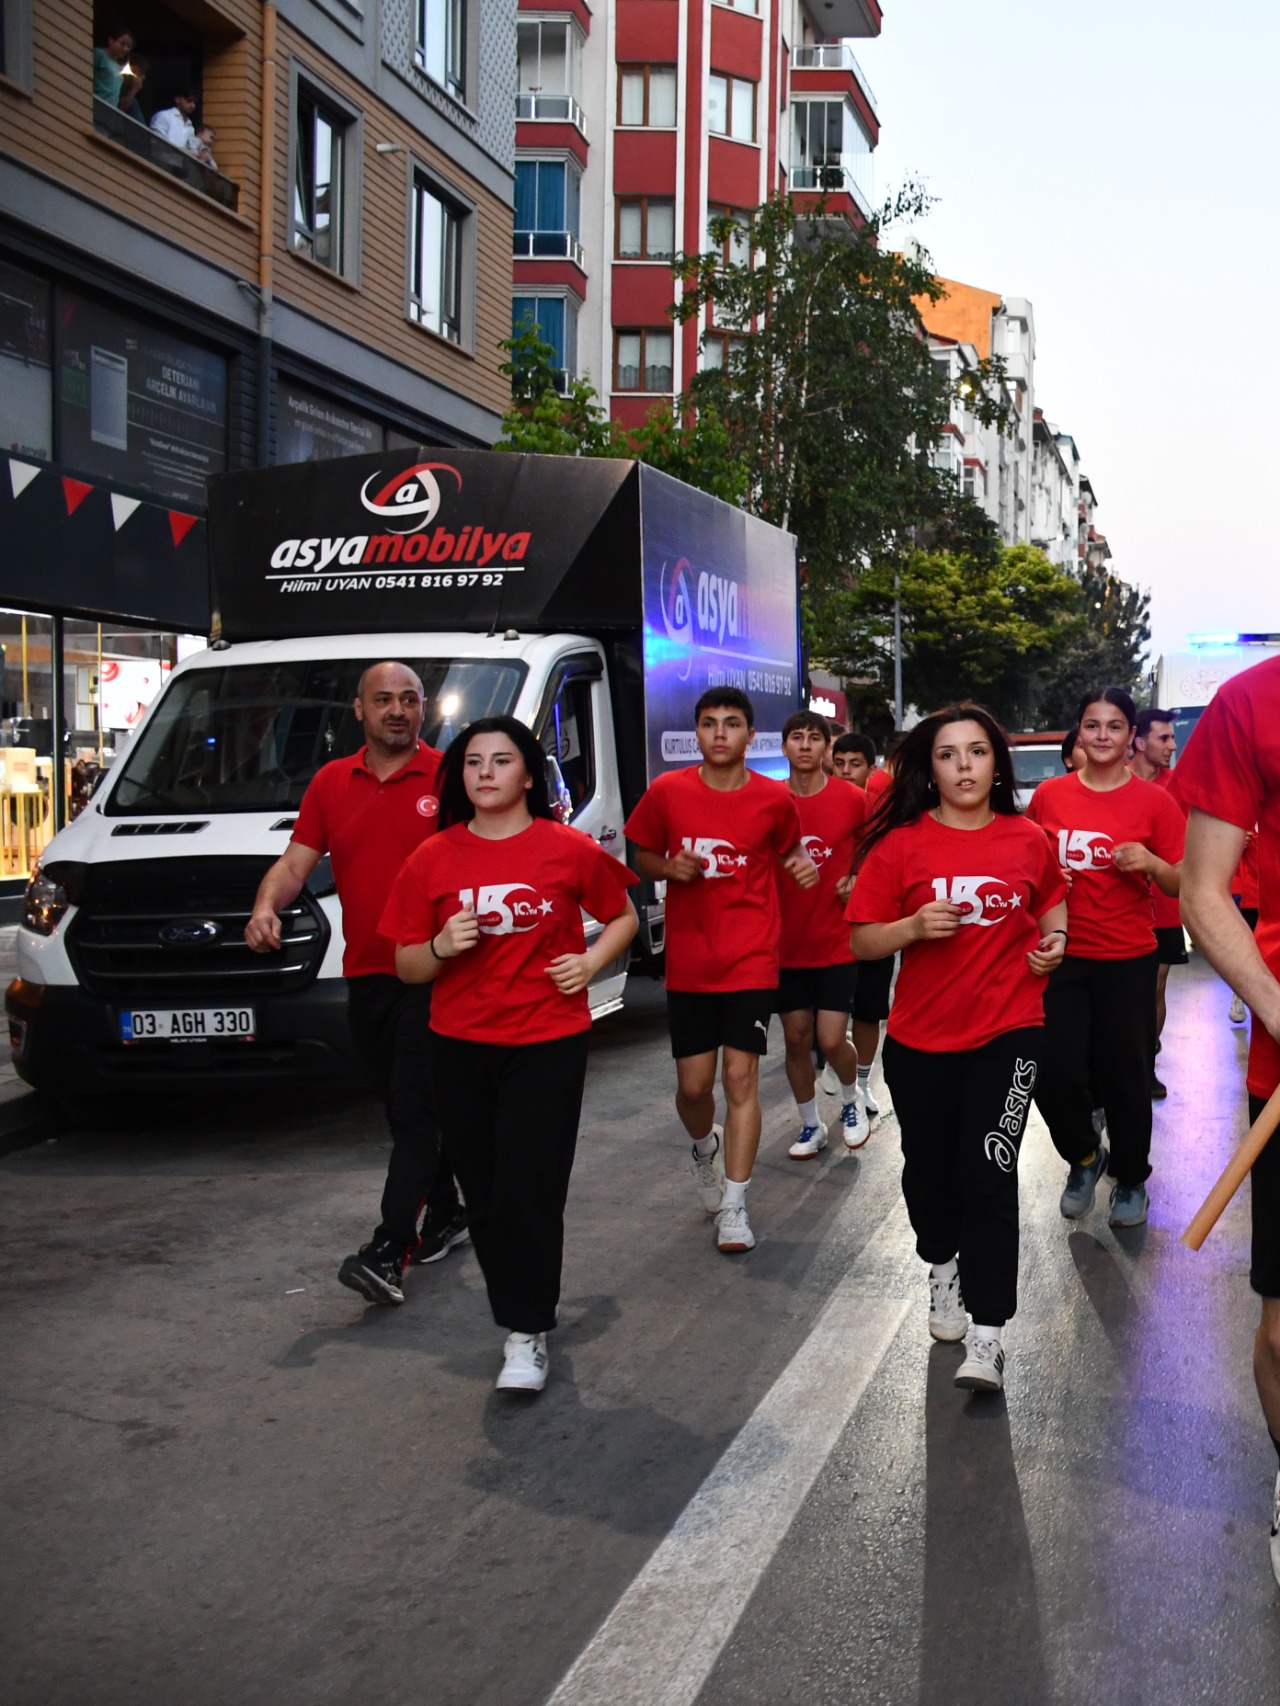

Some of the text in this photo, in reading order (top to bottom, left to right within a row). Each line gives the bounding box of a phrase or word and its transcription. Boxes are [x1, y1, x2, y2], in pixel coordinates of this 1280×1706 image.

[280, 572, 504, 593] Hilmi UYAN 0541 816 97 92
[748, 669, 764, 693] 0541
[132, 1010, 250, 1035] 03 AGH 330
[998, 1057, 1038, 1136] asics
